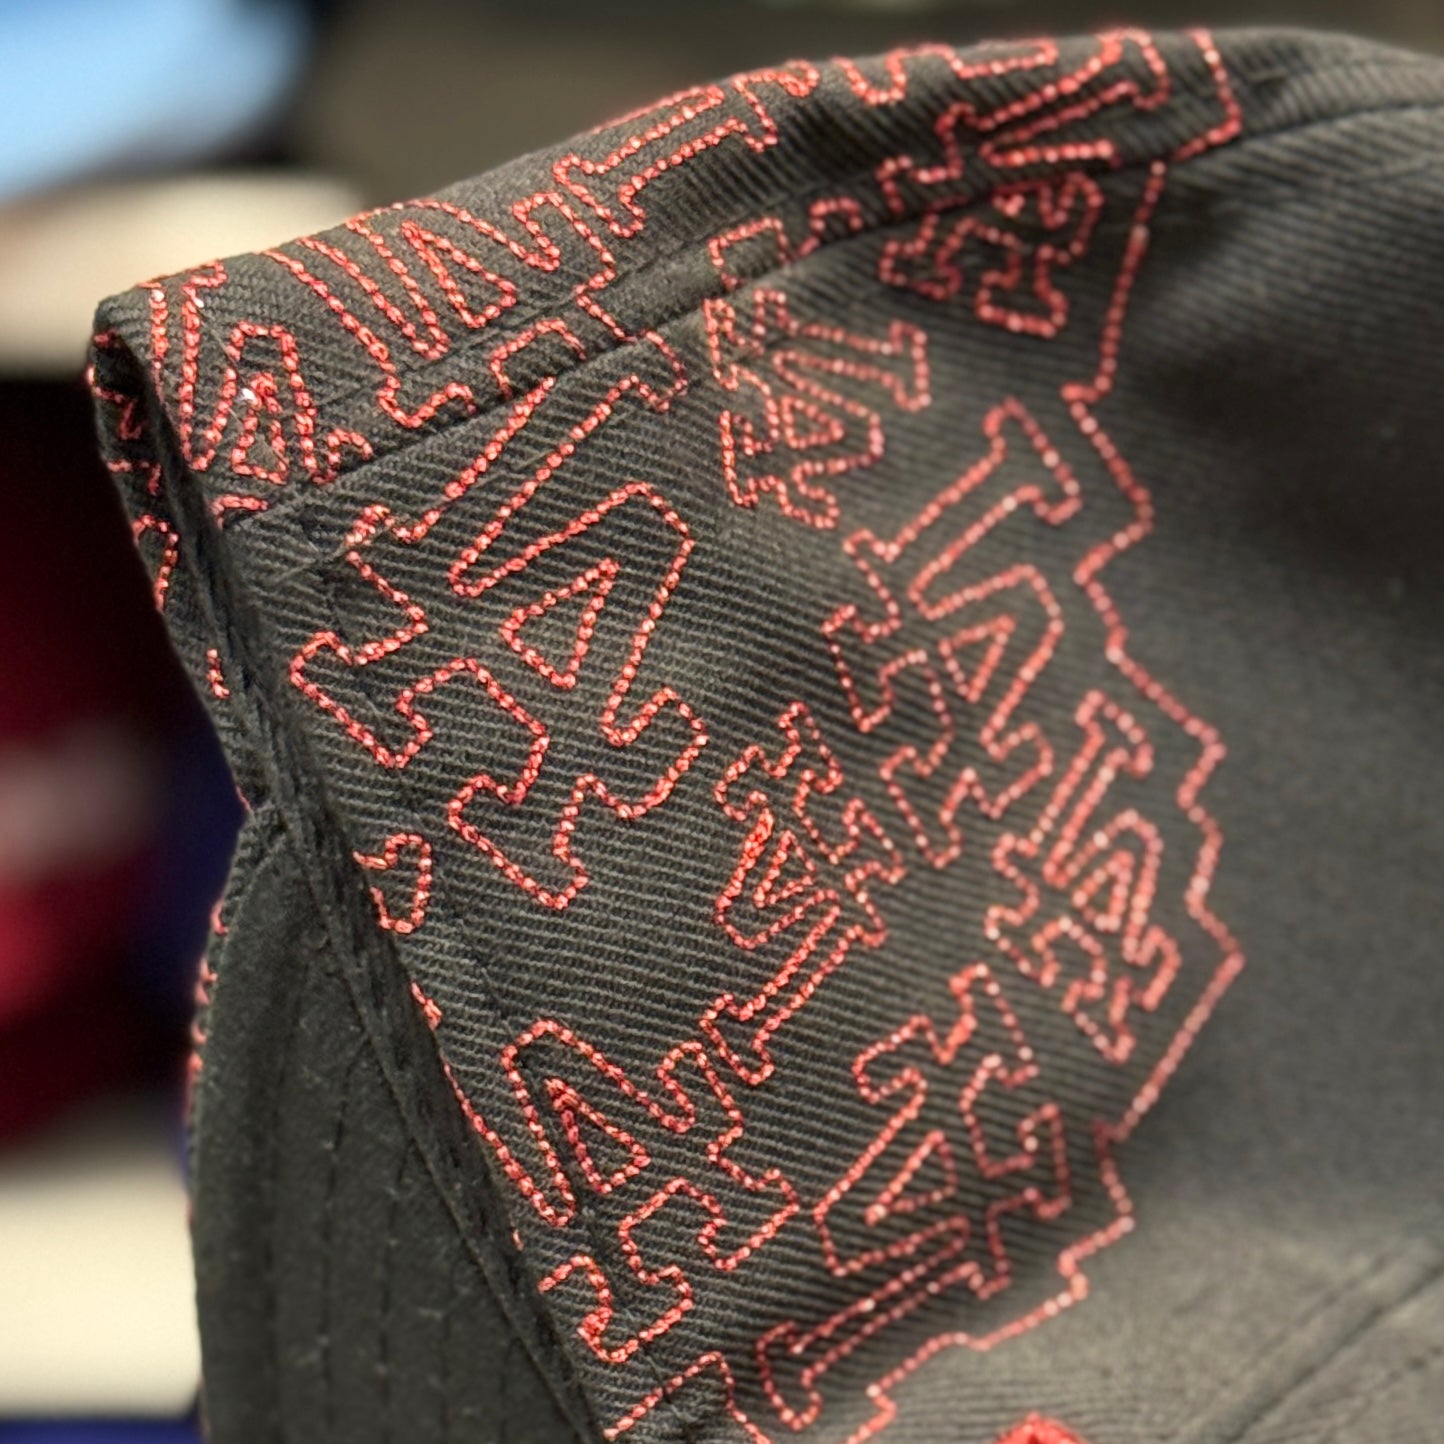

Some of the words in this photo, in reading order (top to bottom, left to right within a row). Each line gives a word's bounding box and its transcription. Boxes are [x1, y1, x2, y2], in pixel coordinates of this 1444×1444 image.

[289, 332, 709, 911] LA
[821, 398, 1081, 869] LA
[984, 690, 1181, 1065] LA
